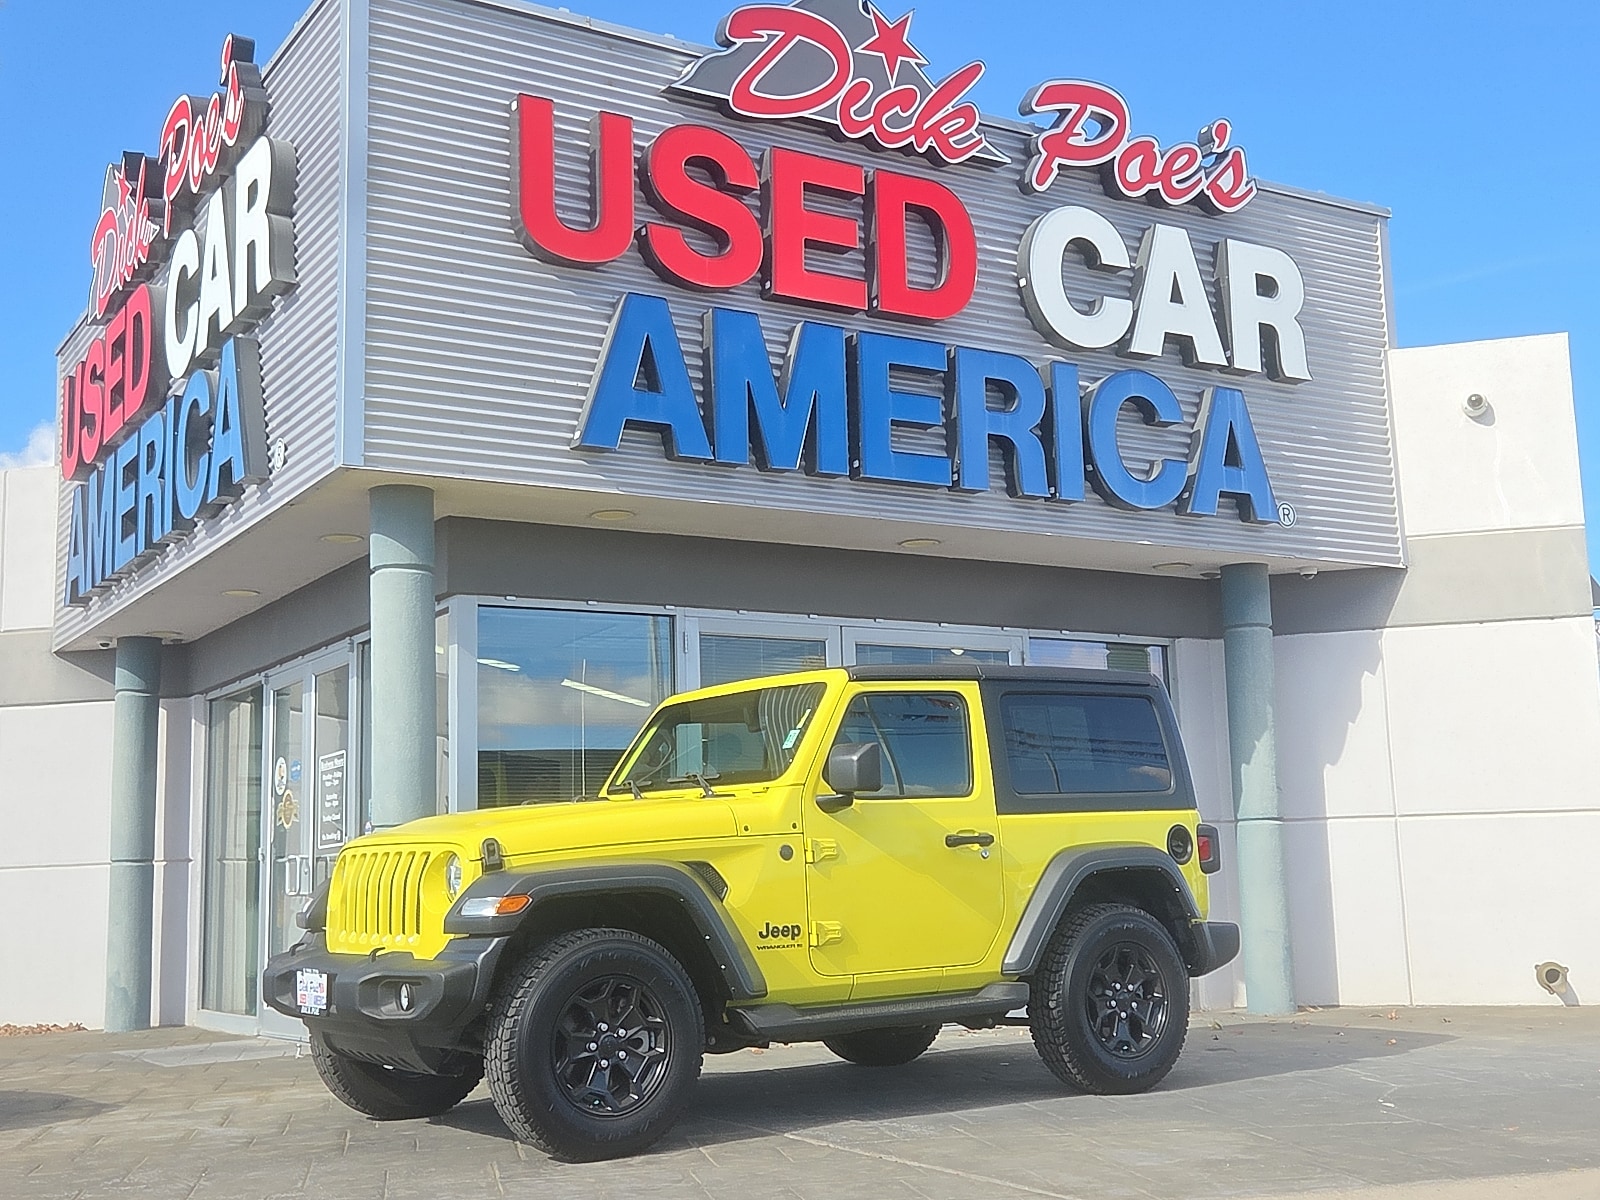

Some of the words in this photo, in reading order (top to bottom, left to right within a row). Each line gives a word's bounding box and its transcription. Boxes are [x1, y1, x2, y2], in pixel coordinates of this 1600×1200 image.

[90, 156, 150, 319] Dick
[158, 33, 245, 239] Poe's
[518, 94, 978, 321] USED
[1028, 205, 1313, 382] CAR
[726, 4, 987, 164] Dick
[1029, 80, 1257, 213] Poe's
[62, 282, 151, 481] USED
[165, 134, 272, 379] CAR
[578, 293, 1279, 523] AMERICA
[64, 336, 245, 608] AMERICA
[758, 922, 801, 941] Jeep
